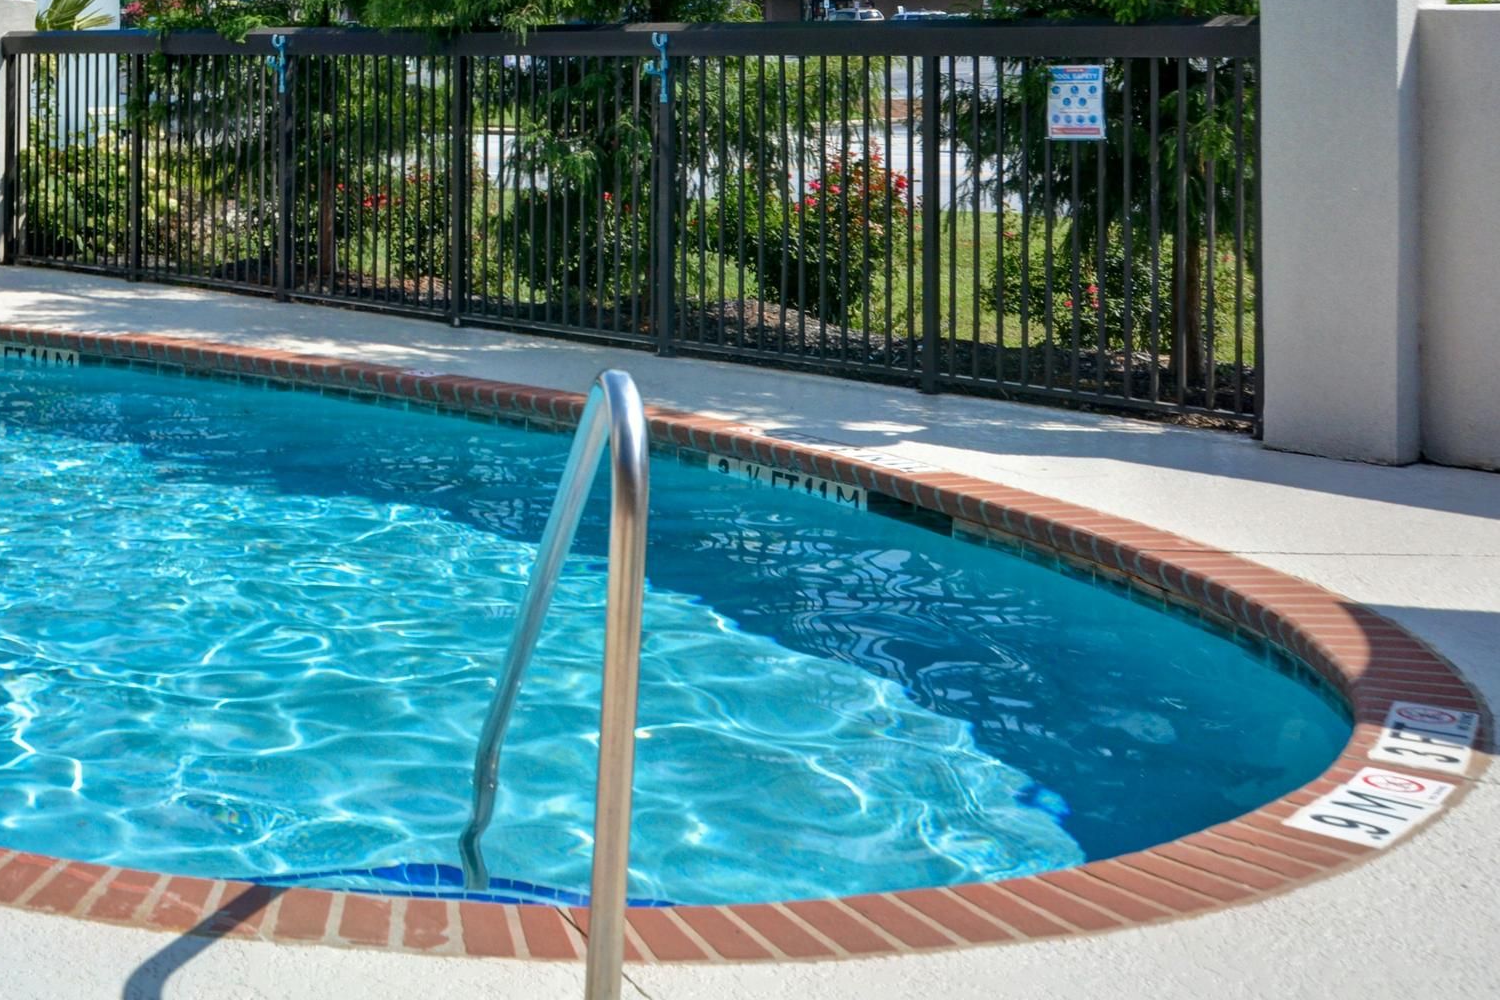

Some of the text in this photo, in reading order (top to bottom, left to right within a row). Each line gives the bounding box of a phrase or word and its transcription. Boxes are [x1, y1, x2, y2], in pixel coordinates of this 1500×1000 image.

[1381, 721, 1469, 764] 3 FT
[1329, 789, 1425, 822] M
